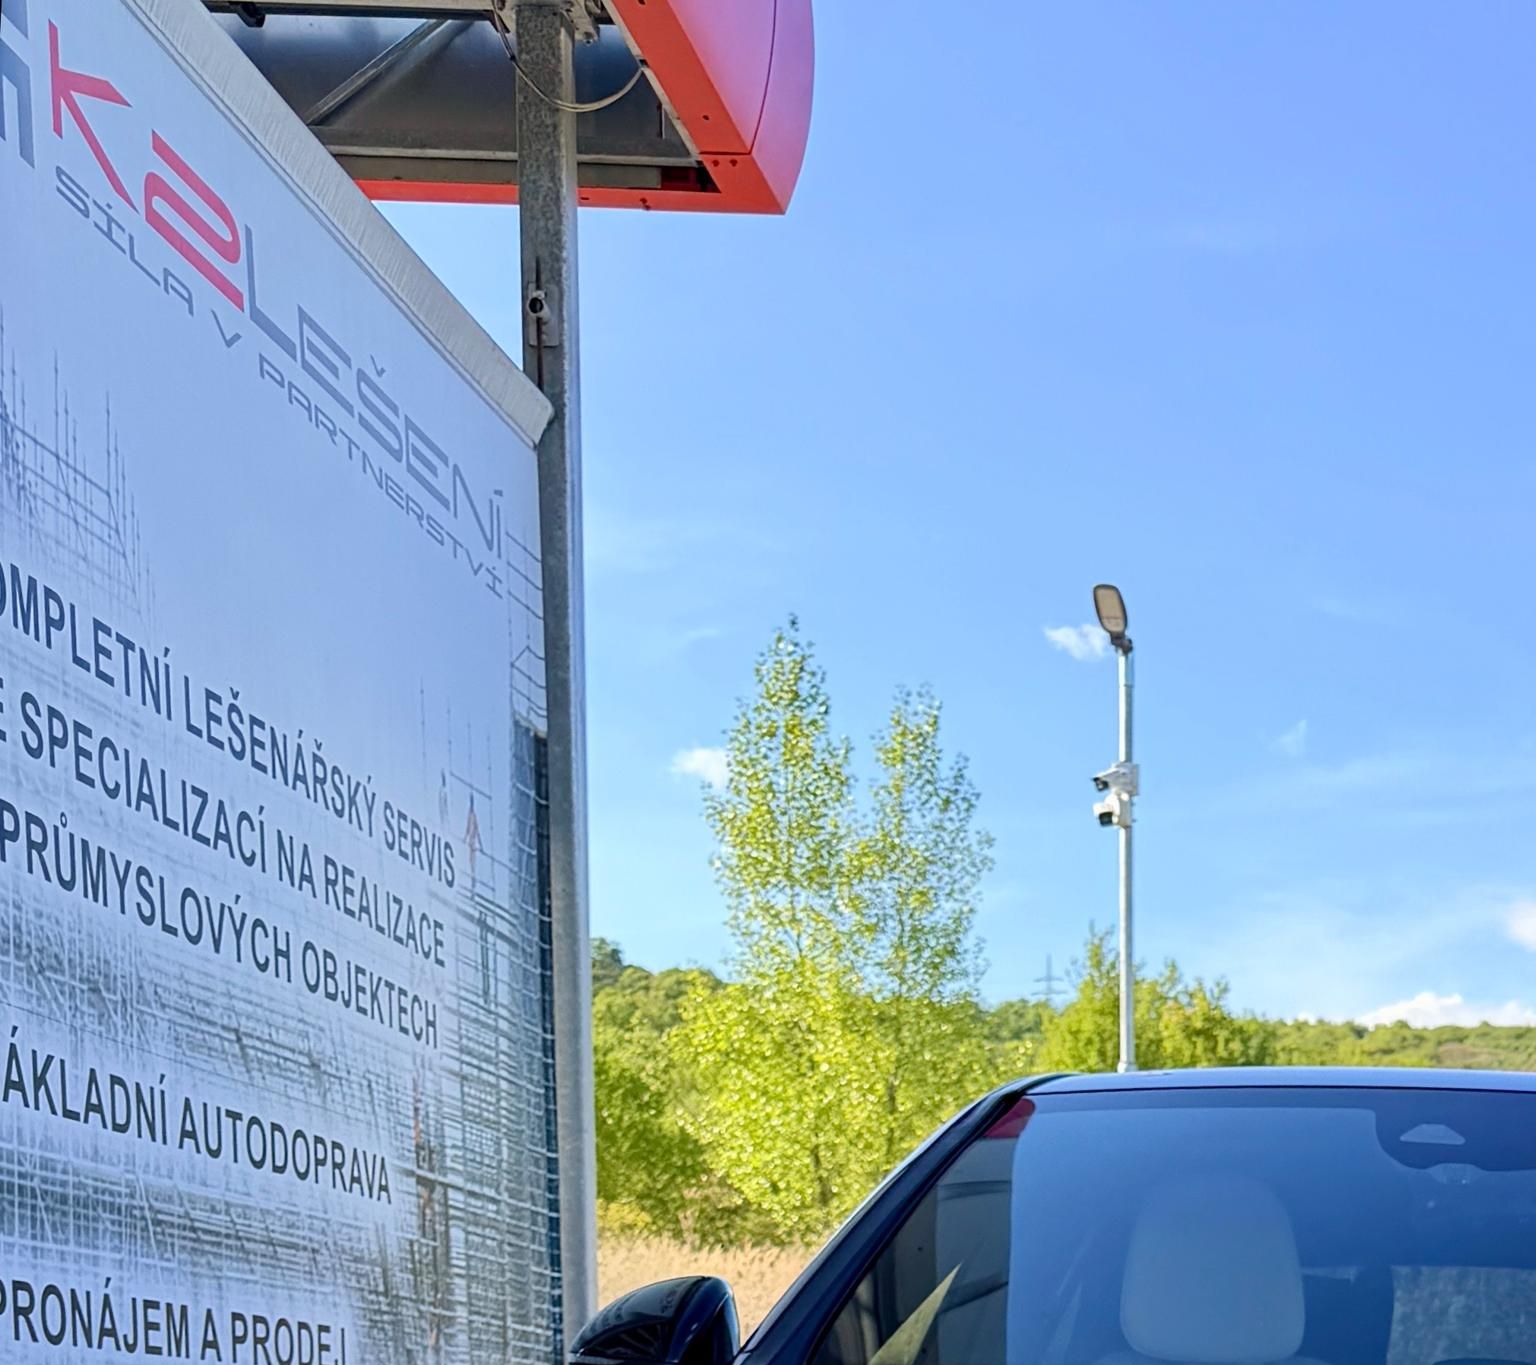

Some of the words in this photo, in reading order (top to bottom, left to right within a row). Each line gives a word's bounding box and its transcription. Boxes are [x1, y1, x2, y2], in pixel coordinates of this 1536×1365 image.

[211, 309, 242, 348] V
[20, 692, 266, 873] SPECIALIZACÍ
[276, 828, 317, 905] NA
[324, 854, 446, 968] REALIZACE
[184, 673, 376, 852] LEŠENÁŘSKÝ
[383, 800, 456, 889] SERVIS
[0, 797, 292, 984] PRŮMYSLOVÝCH
[302, 941, 438, 1050] OBJEKTECH
[178, 1097, 391, 1204] AUTODOPRAVA
[200, 1308, 222, 1363] A
